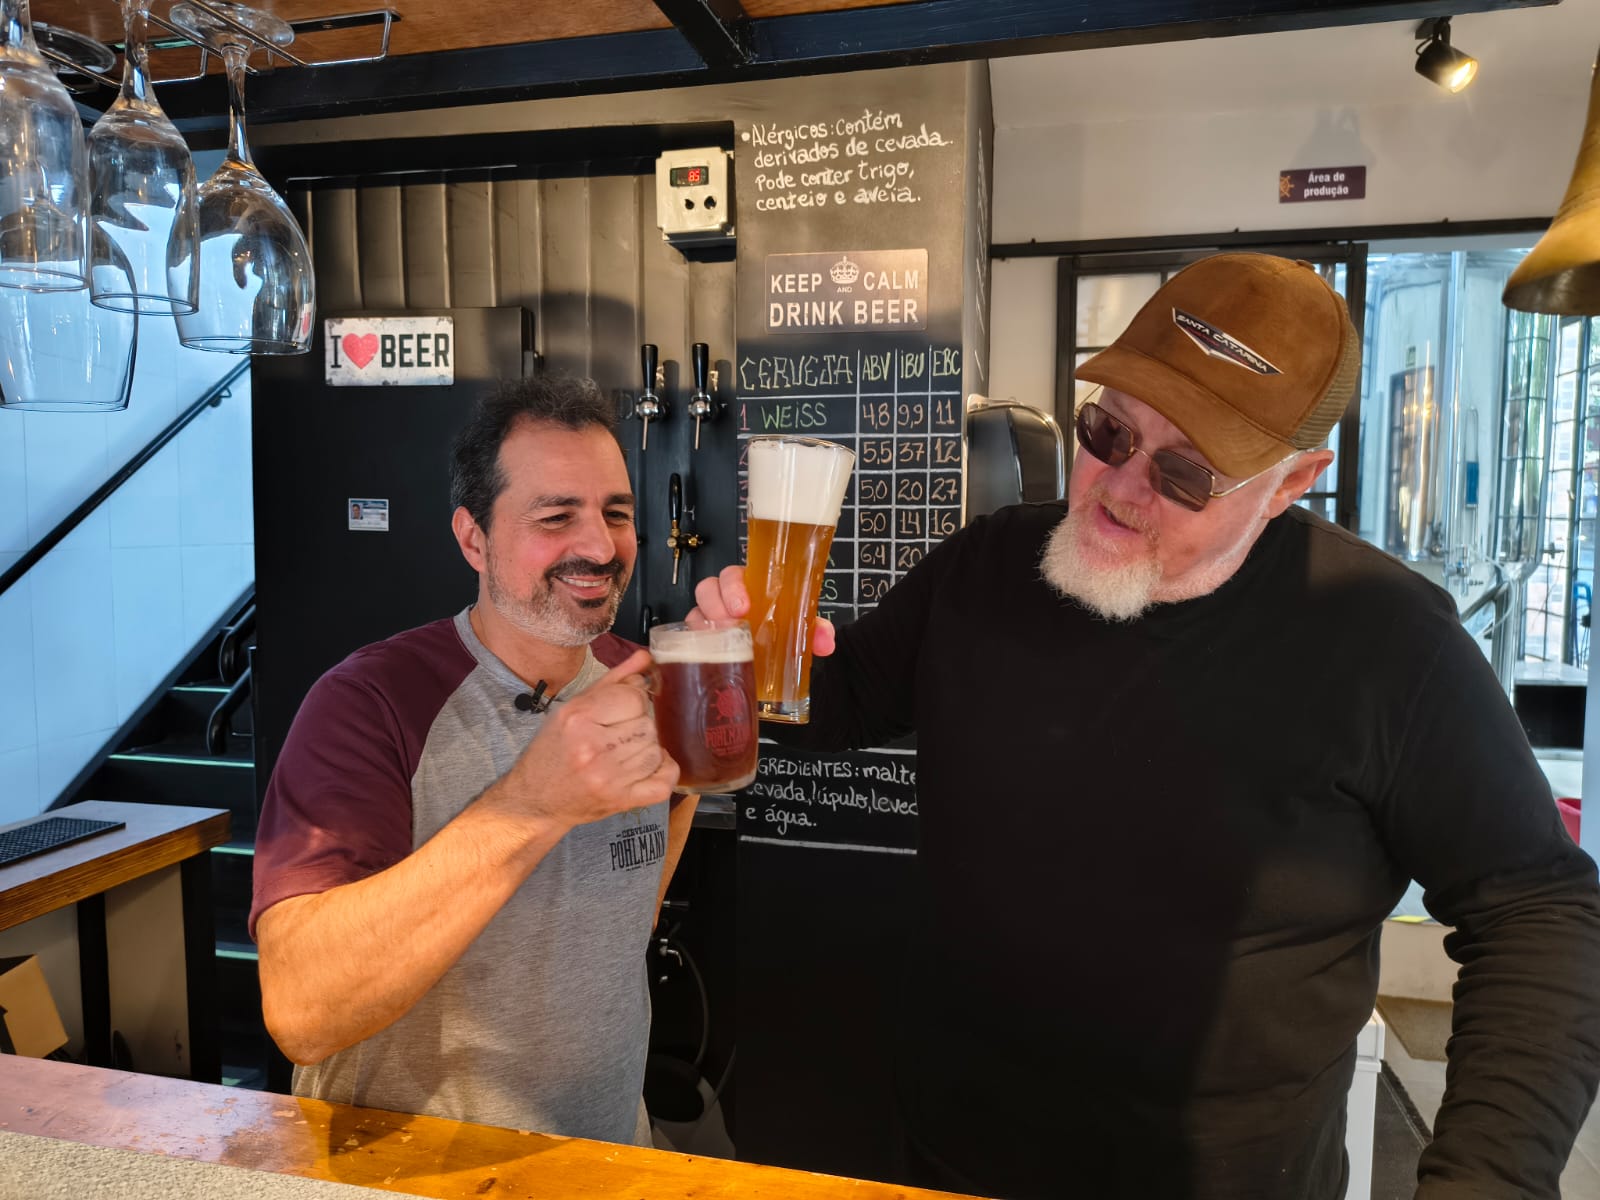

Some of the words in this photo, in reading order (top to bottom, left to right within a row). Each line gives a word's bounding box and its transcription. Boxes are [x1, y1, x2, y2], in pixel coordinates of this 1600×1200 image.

[754, 141, 839, 168] derivados
[845, 136, 869, 156] de
[875, 123, 954, 153] cevada.
[755, 169, 796, 191] Pode
[801, 167, 853, 187] conter
[858, 160, 915, 188] trigo,
[1308, 170, 1331, 183] Área
[1333, 171, 1345, 182] de
[756, 190, 827, 211] centeio
[834, 190, 846, 205] e
[1303, 185, 1349, 199] produção
[771, 273, 823, 293] KEEP
[863, 270, 919, 291] CALM
[837, 286, 853, 294] AND
[769, 301, 844, 327] DRINK
[854, 299, 919, 325] BEER
[1177, 314, 1210, 335] SANTA
[330, 335, 342, 368] I
[381, 333, 449, 368] BEER
[740, 355, 853, 390] CERVEJA
[862, 352, 891, 381] ABV
[933, 347, 961, 377] EBC
[739, 403, 750, 431] 1
[863, 402, 890, 431] 4,8
[897, 404, 924, 429] 9,9
[935, 399, 955, 425] 11
[863, 441, 892, 464] 5,5
[899, 442, 925, 463] 37
[935, 437, 960, 463] 12
[861, 480, 888, 502] 5,0
[897, 479, 923, 501] 20
[931, 478, 958, 502] 27
[900, 511, 921, 535] 14
[930, 510, 956, 535] 16
[860, 544, 886, 566] 6,4
[746, 807, 757, 819] e
[765, 804, 817, 836] água.
[609, 831, 665, 871] POHLMANN
